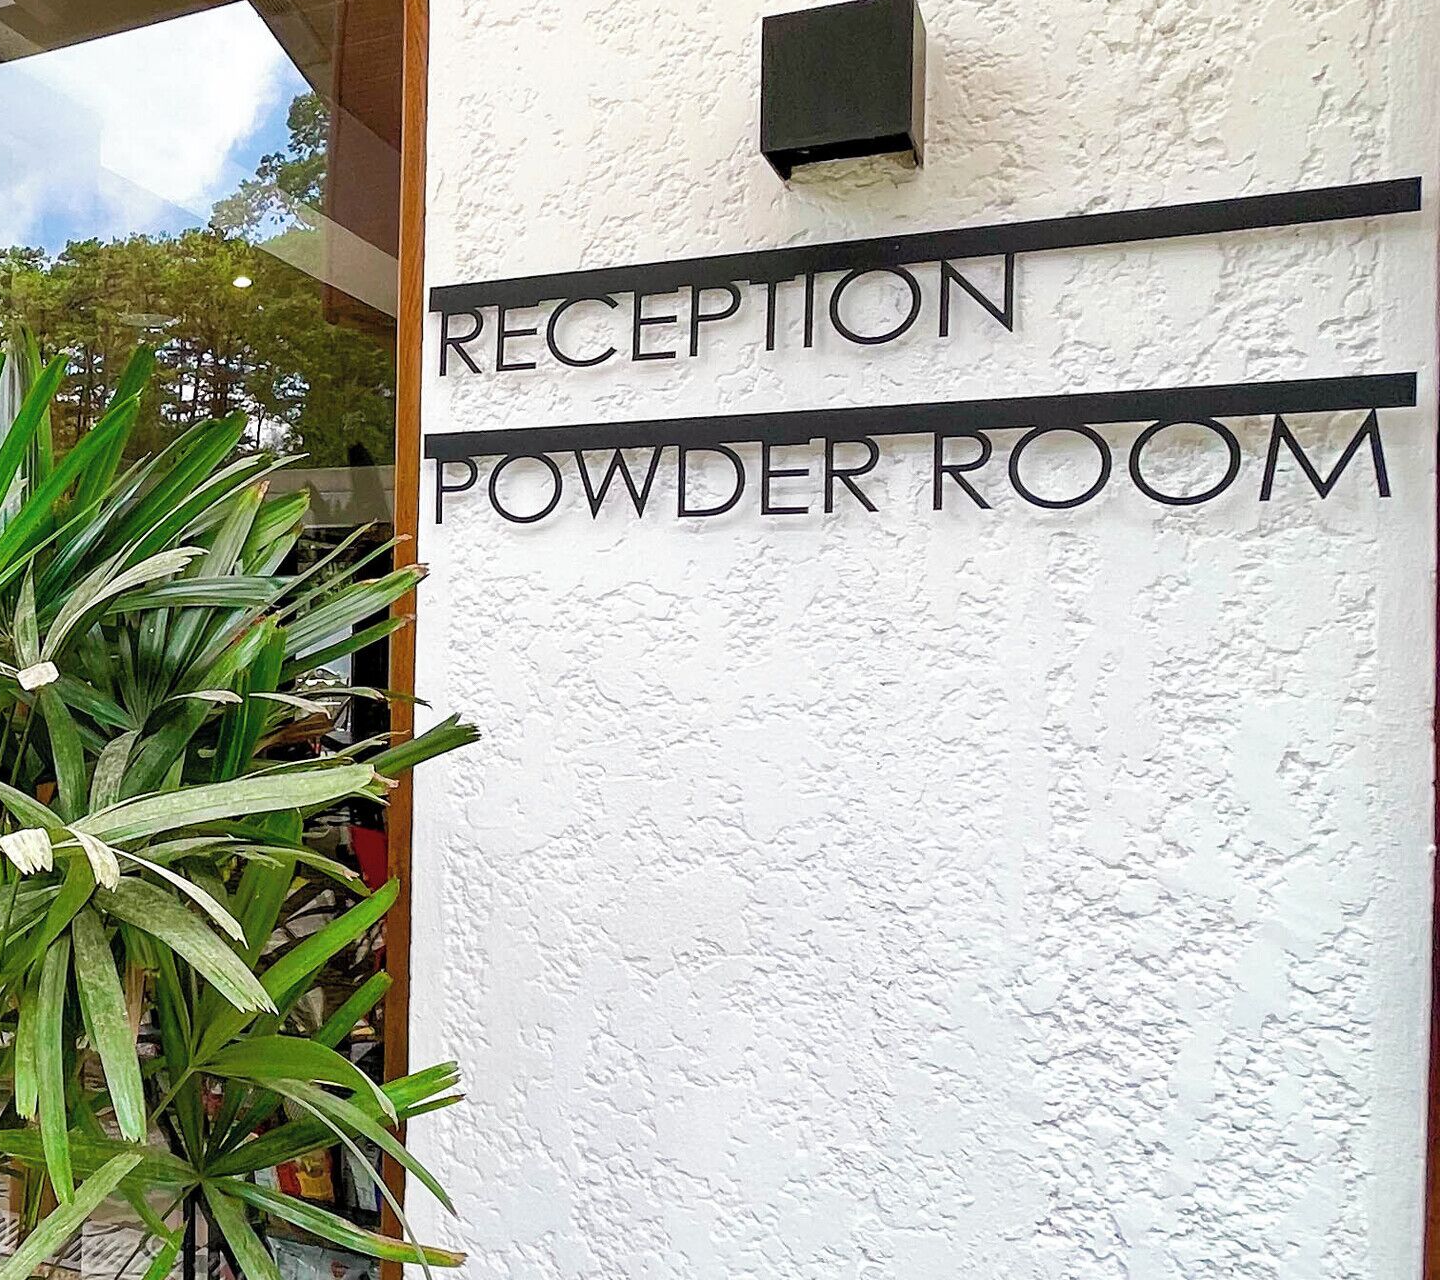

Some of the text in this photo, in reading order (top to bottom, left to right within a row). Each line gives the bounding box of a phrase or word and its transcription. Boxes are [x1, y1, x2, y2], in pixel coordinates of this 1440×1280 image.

[439, 253, 1015, 377] RECEPTION
[435, 408, 1392, 524] POWDER ROOM
